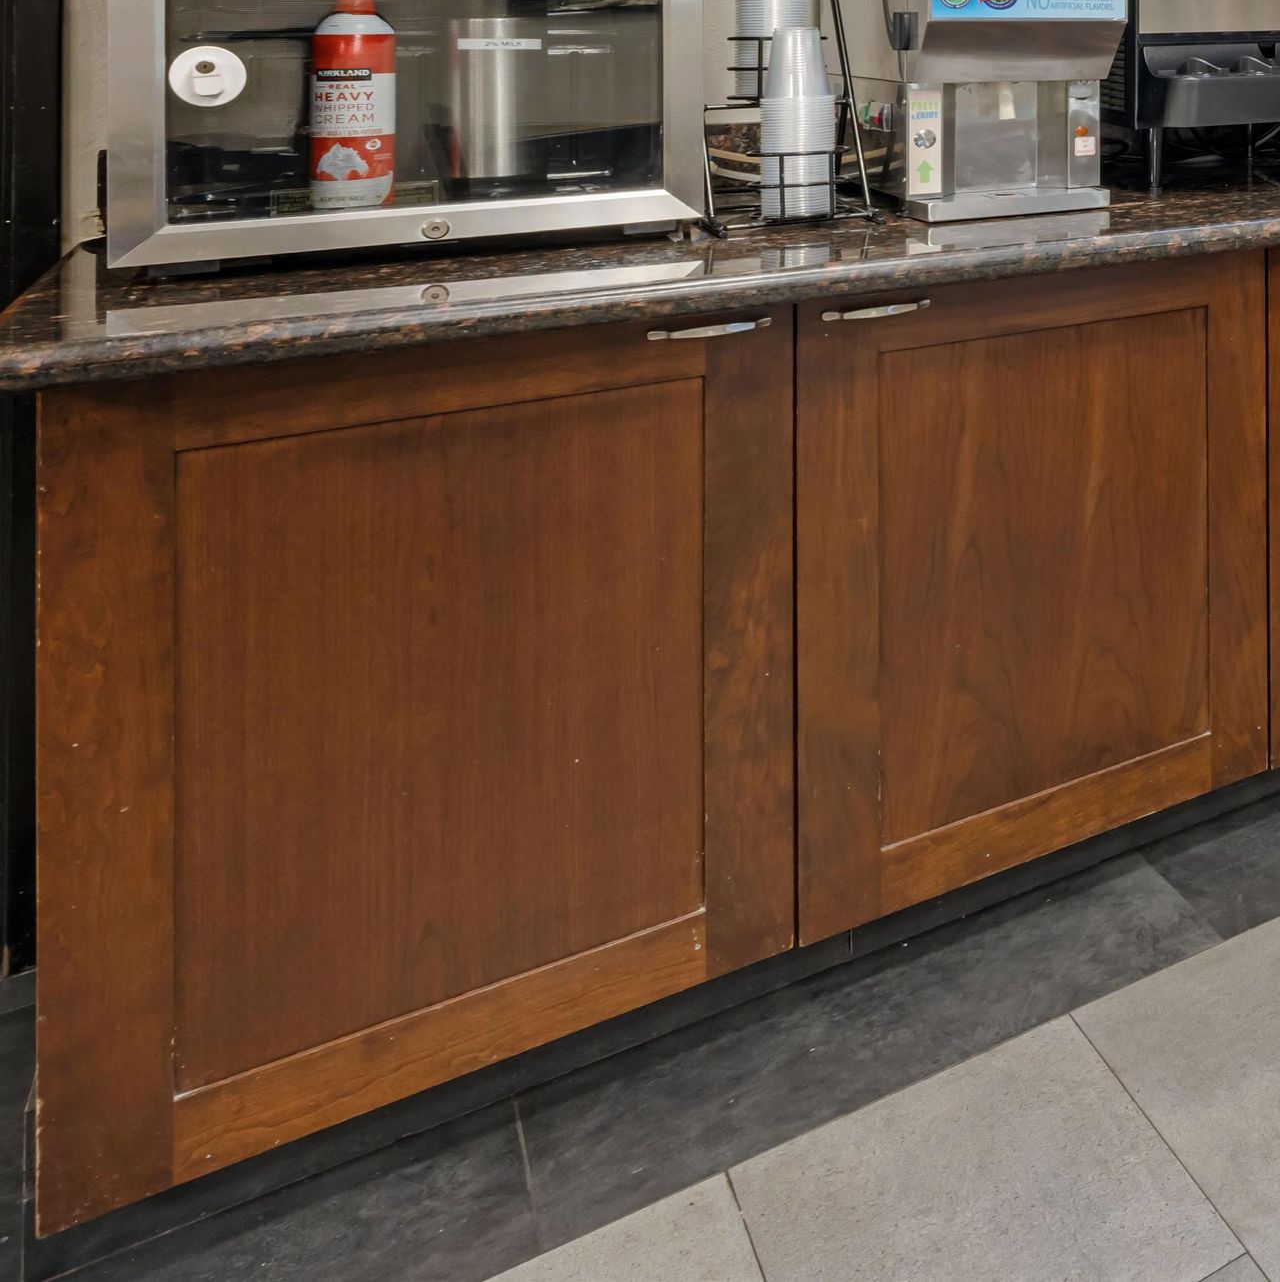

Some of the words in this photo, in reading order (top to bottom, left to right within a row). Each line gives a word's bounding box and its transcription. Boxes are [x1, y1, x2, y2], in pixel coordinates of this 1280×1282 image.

[1051, 1, 1084, 11] ARTIFICIAL
[314, 91, 374, 102] HEAVY
[314, 104, 375, 112] WHIPPED
[314, 113, 375, 124] CREAM
